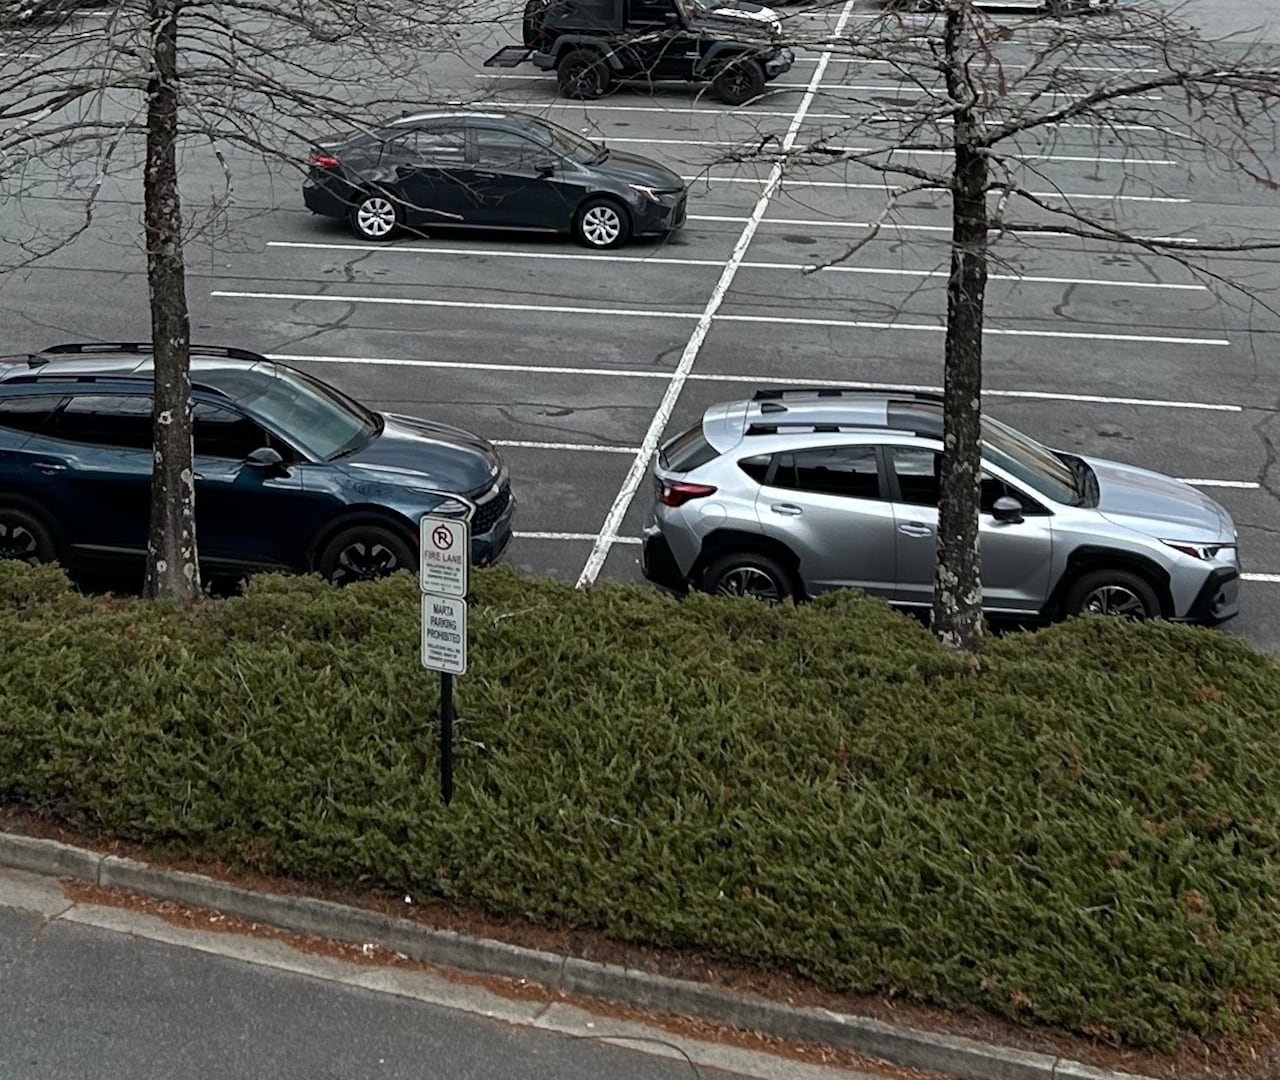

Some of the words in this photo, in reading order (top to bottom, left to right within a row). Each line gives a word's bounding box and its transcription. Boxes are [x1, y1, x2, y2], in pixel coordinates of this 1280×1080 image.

[425, 551, 440, 561] FIRE
[442, 553, 461, 564] LANE
[433, 603, 454, 617] MARTA
[430, 616, 457, 630] PARKING
[427, 628, 460, 644] PROHIBITED
